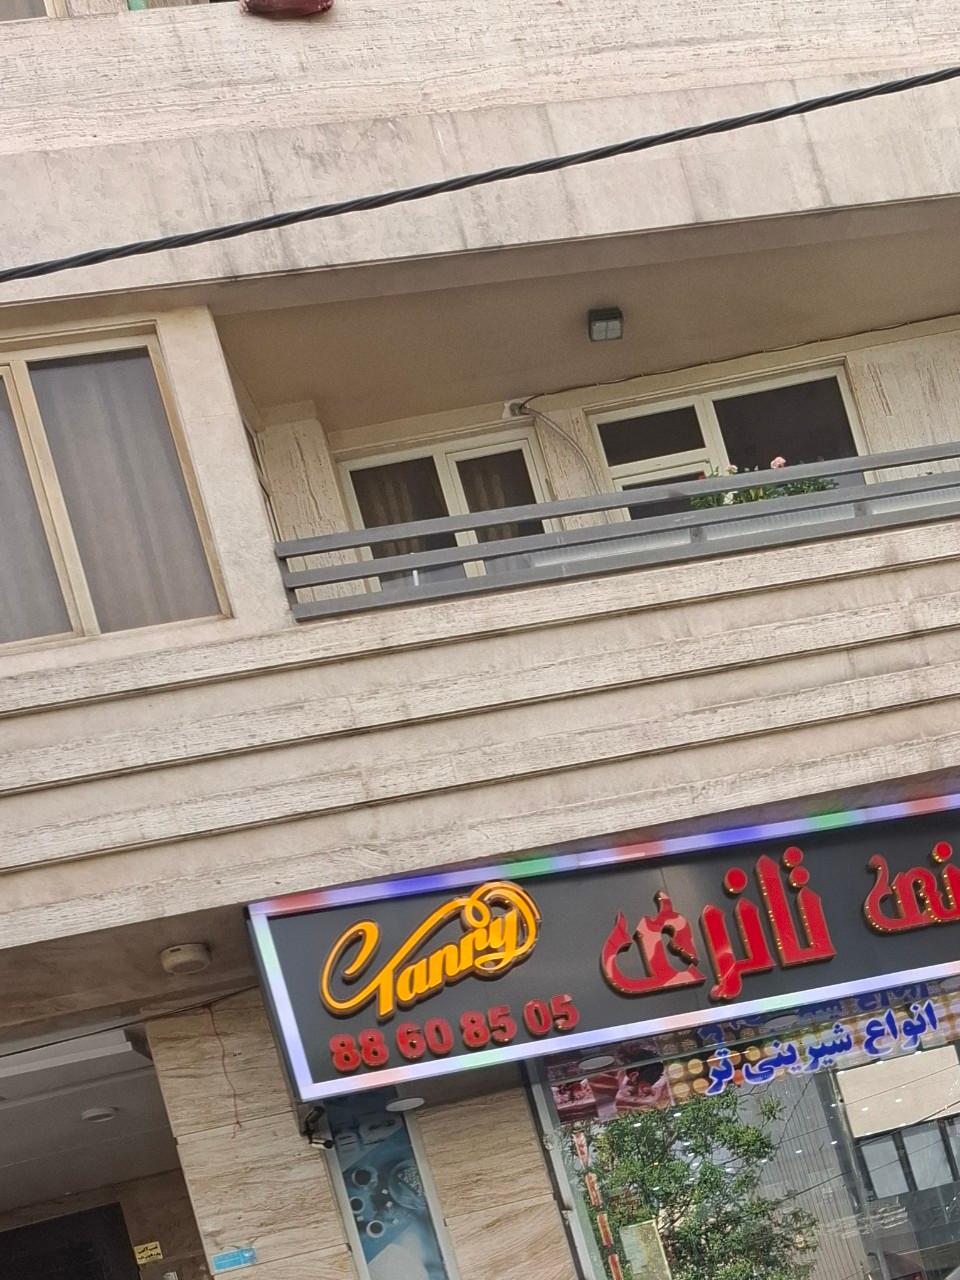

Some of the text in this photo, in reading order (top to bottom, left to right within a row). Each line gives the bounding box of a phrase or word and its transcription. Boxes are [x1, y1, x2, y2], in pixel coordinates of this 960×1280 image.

[320, 878, 543, 1022] Tanry
[329, 994, 582, 1074] 88 60 85 05
[705, 999, 939, 1096] انواع شیرینی تر
